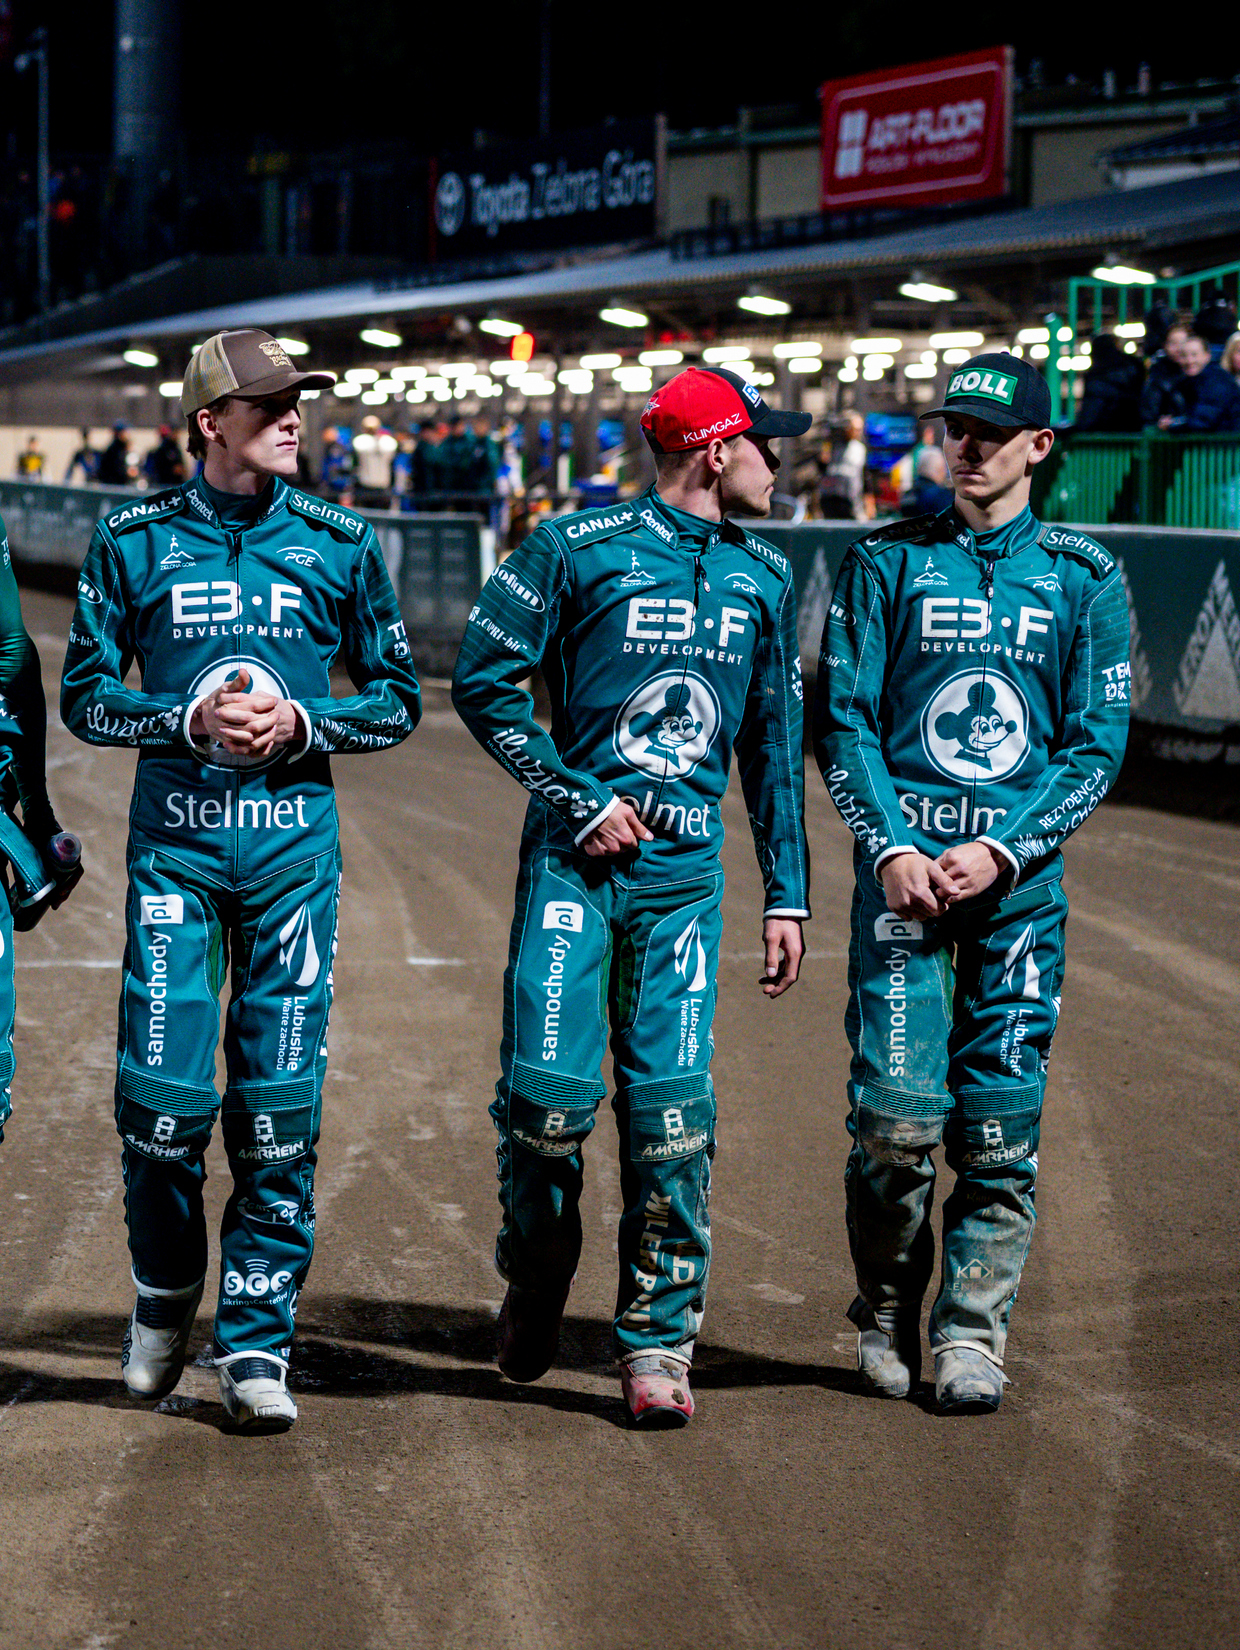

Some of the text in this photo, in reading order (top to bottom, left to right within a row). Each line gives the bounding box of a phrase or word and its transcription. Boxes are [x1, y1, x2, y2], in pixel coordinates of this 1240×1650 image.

[948, 371, 1009, 399] BOLL
[683, 412, 743, 444] KLIMGAZ
[108, 495, 182, 528] CANAL+
[186, 487, 213, 521] Pentel
[292, 493, 365, 537] Stelmet
[566, 510, 635, 539] CANAL+
[639, 508, 674, 543] Pentel
[284, 552, 315, 568] PGE
[745, 537, 788, 573] elmet
[1046, 531, 1114, 573] Stelmet
[732, 580, 757, 594] PGE
[172, 624, 304, 639] DEVELOPMENT
[622, 641, 743, 665] DEVELOPMENT
[921, 641, 1046, 664] DEVELOPMENT
[486, 739, 520, 779] HURTOWNIA
[492, 727, 569, 806] iluzja
[164, 790, 310, 829] Stelmet
[824, 764, 869, 842] iluzja
[900, 792, 1008, 835] Stelm
[1038, 766, 1106, 830] REZYDENCJA
[1047, 779, 1110, 847] DYCHÓW
[146, 931, 173, 1066] samochody
[542, 934, 571, 1061] samochody
[883, 946, 912, 1077] samochody
[276, 996, 292, 1071] Warte zachodu
[287, 996, 309, 1072] Lubuskie
[677, 1000, 689, 1067] Warte zachodu
[687, 998, 703, 1068] Lubuskie
[1011, 1008, 1033, 1078] Lubuskie
[125, 1133, 191, 1158] AMRHEIN
[238, 1140, 305, 1160] AMRHEIN
[641, 1131, 708, 1157] AMRHEIN
[962, 1142, 1029, 1164] AMRHEIN
[226, 1274, 290, 1293] SCS
